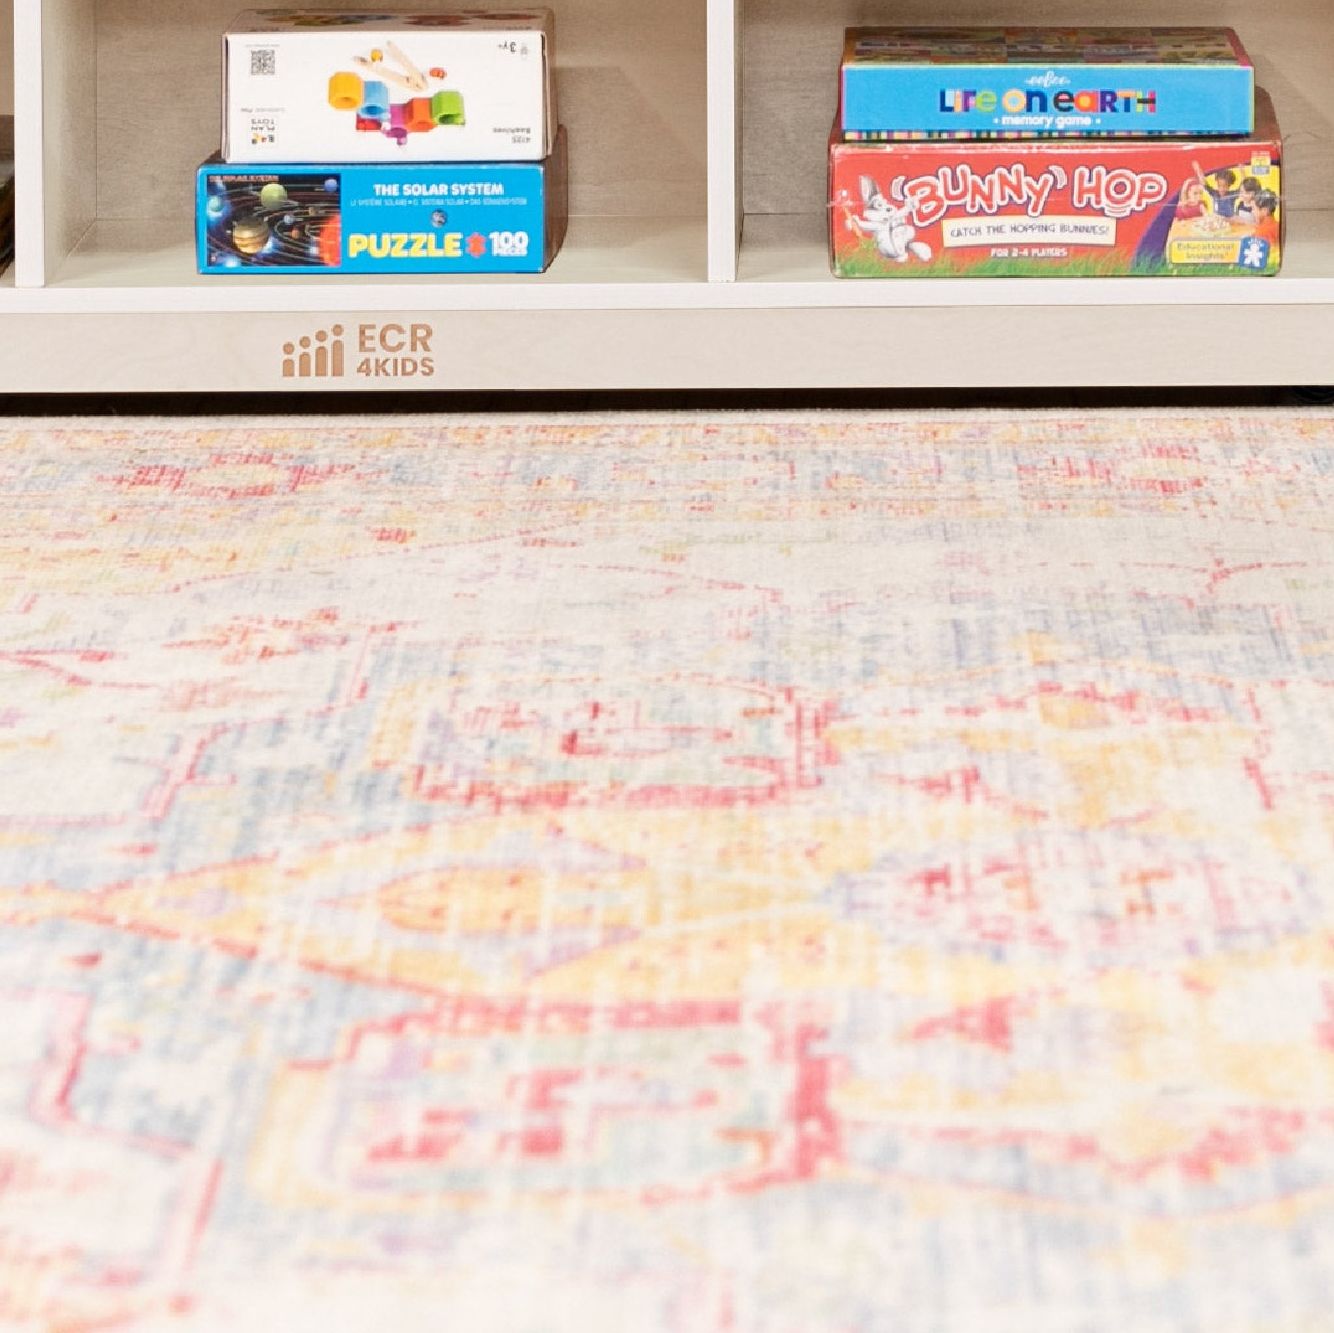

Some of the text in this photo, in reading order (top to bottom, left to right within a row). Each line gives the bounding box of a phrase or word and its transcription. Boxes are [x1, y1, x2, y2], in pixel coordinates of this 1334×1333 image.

[1001, 116, 1091, 130] memory game
[373, 182, 505, 196] THE SOLAR SYSTEM
[905, 164, 1167, 226] BUNNY HOP
[987, 224, 1005, 234] THE
[1010, 223, 1055, 233] HOPPING
[348, 231, 529, 258] PUZZLE 100
[358, 324, 434, 353] ECR
[356, 357, 435, 377] 4KIDS
